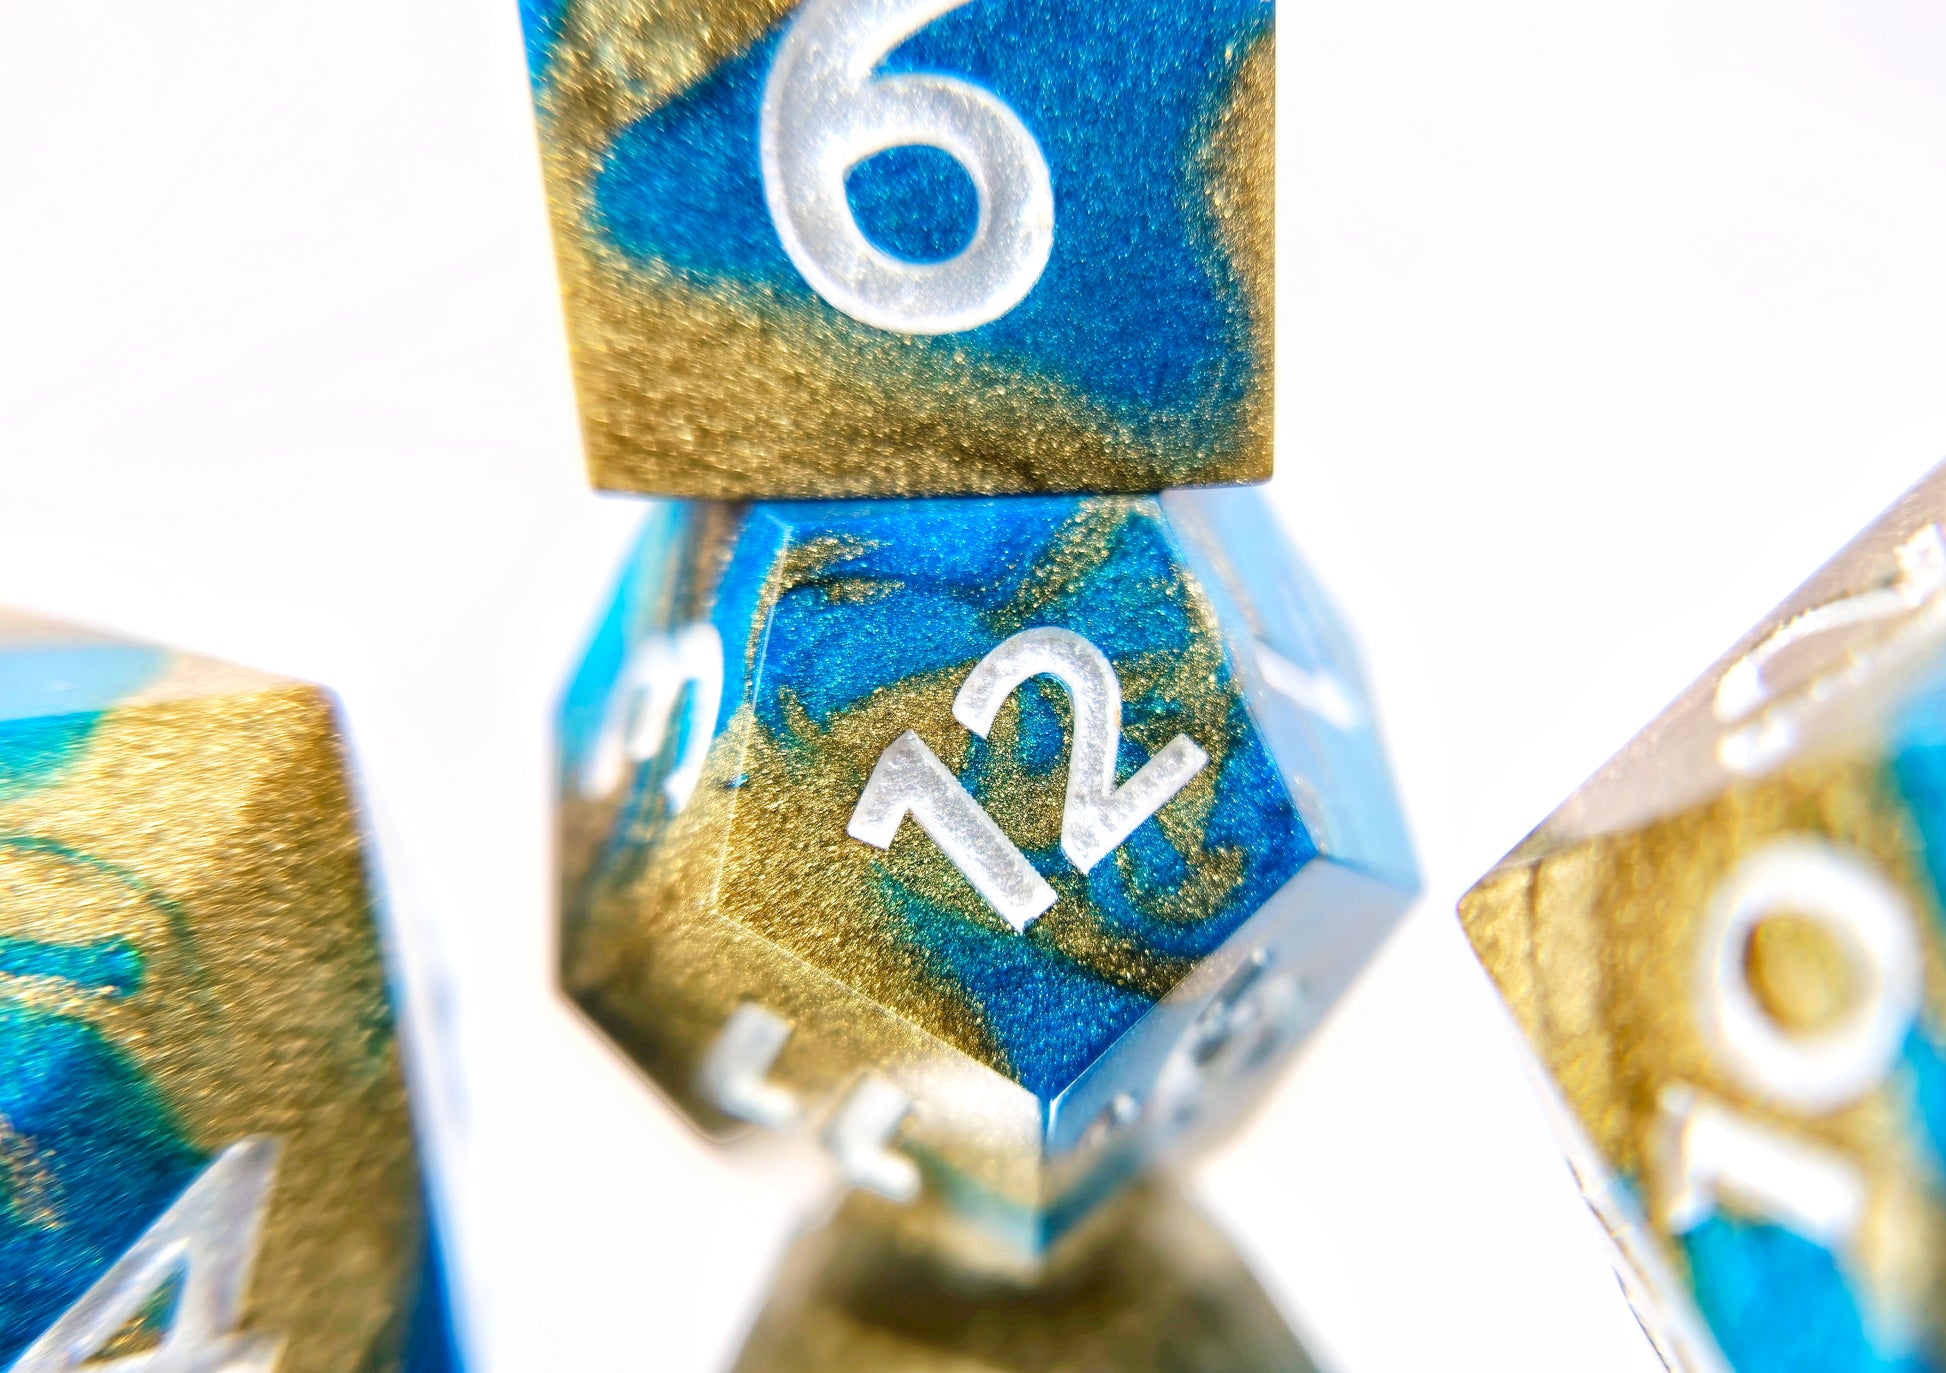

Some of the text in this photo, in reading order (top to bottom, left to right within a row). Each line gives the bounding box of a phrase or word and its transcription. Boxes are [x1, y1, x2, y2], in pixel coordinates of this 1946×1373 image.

[760, 0, 1055, 334] 6
[847, 627, 1207, 933] 12
[1656, 836, 1920, 1242] 10
